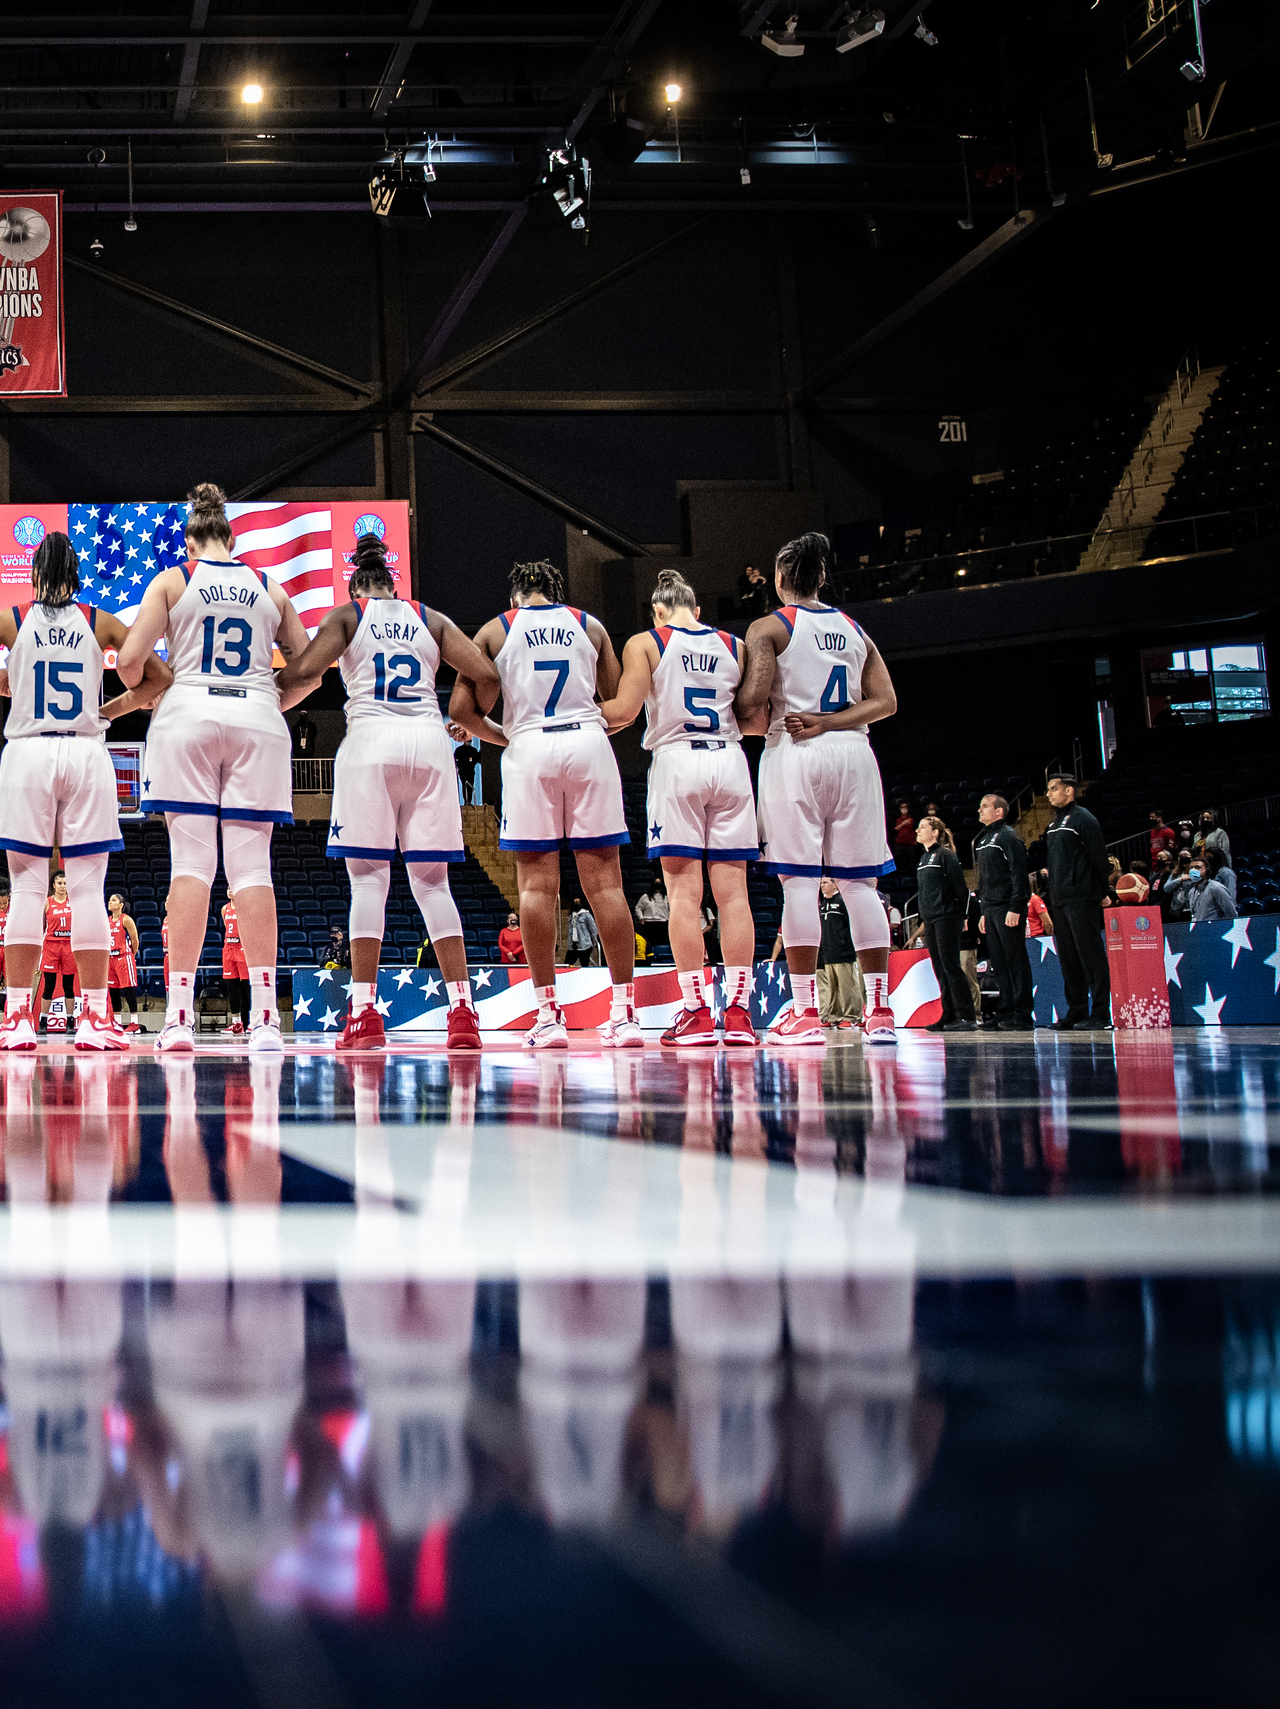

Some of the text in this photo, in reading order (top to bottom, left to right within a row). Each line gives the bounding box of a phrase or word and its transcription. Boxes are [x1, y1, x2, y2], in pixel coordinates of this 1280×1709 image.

[938, 422, 967, 442] 201
[2, 558, 33, 566] WORL
[199, 585, 259, 608] DOLSON
[201, 615, 252, 676] 13
[525, 628, 575, 648] ATKINS
[815, 632, 847, 652] LOYD
[372, 652, 421, 702] 12
[681, 654, 718, 675] PLUM
[33, 661, 83, 720] 15
[533, 660, 570, 717] 7
[820, 665, 850, 713] 4
[683, 687, 720, 733] 5
